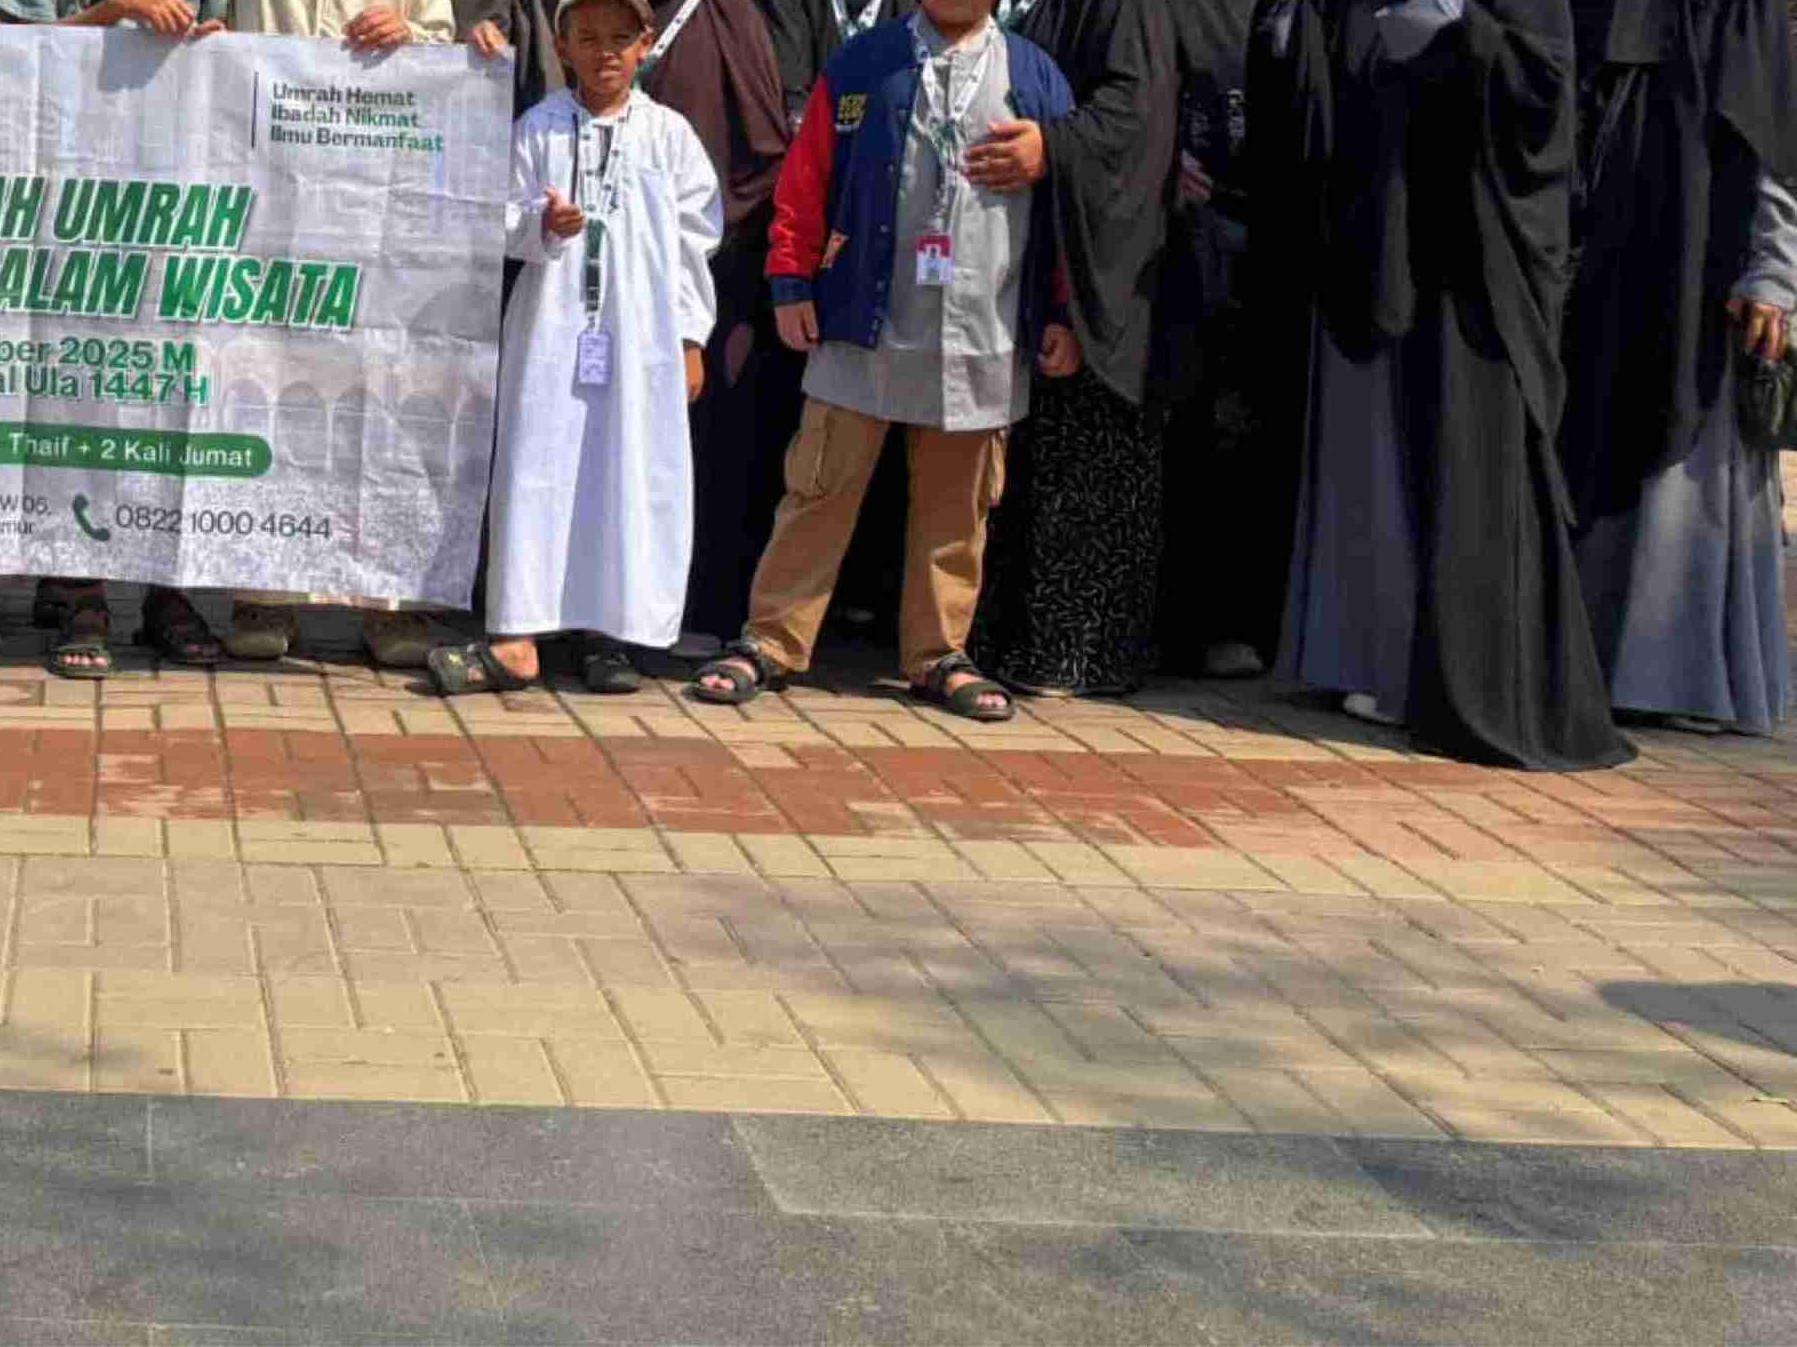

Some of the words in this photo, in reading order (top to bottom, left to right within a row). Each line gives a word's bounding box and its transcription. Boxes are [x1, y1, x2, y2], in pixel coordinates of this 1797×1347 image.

[273, 83, 341, 103] Umrah
[347, 87, 415, 106] Hemat
[271, 105, 340, 124] Ibadah
[347, 108, 419, 128] Nikmat
[270, 125, 312, 145] Ilmu
[316, 127, 444, 152] Bermanfaat
[54, 178, 253, 249] UMRAH
[157, 252, 360, 328] WISATA
[59, 336, 154, 371] 2025
[163, 340, 195, 372] M
[25, 365, 79, 398] Ula
[89, 372, 177, 404] 1447
[183, 375, 207, 405] H
[9, 433, 70, 458] Thaif
[101, 441, 116, 459] 2
[124, 441, 170, 463] Kali
[179, 444, 253, 468] Jumat
[116, 504, 182, 534] 0822
[189, 510, 253, 535] 1000
[260, 513, 331, 539] 4644
